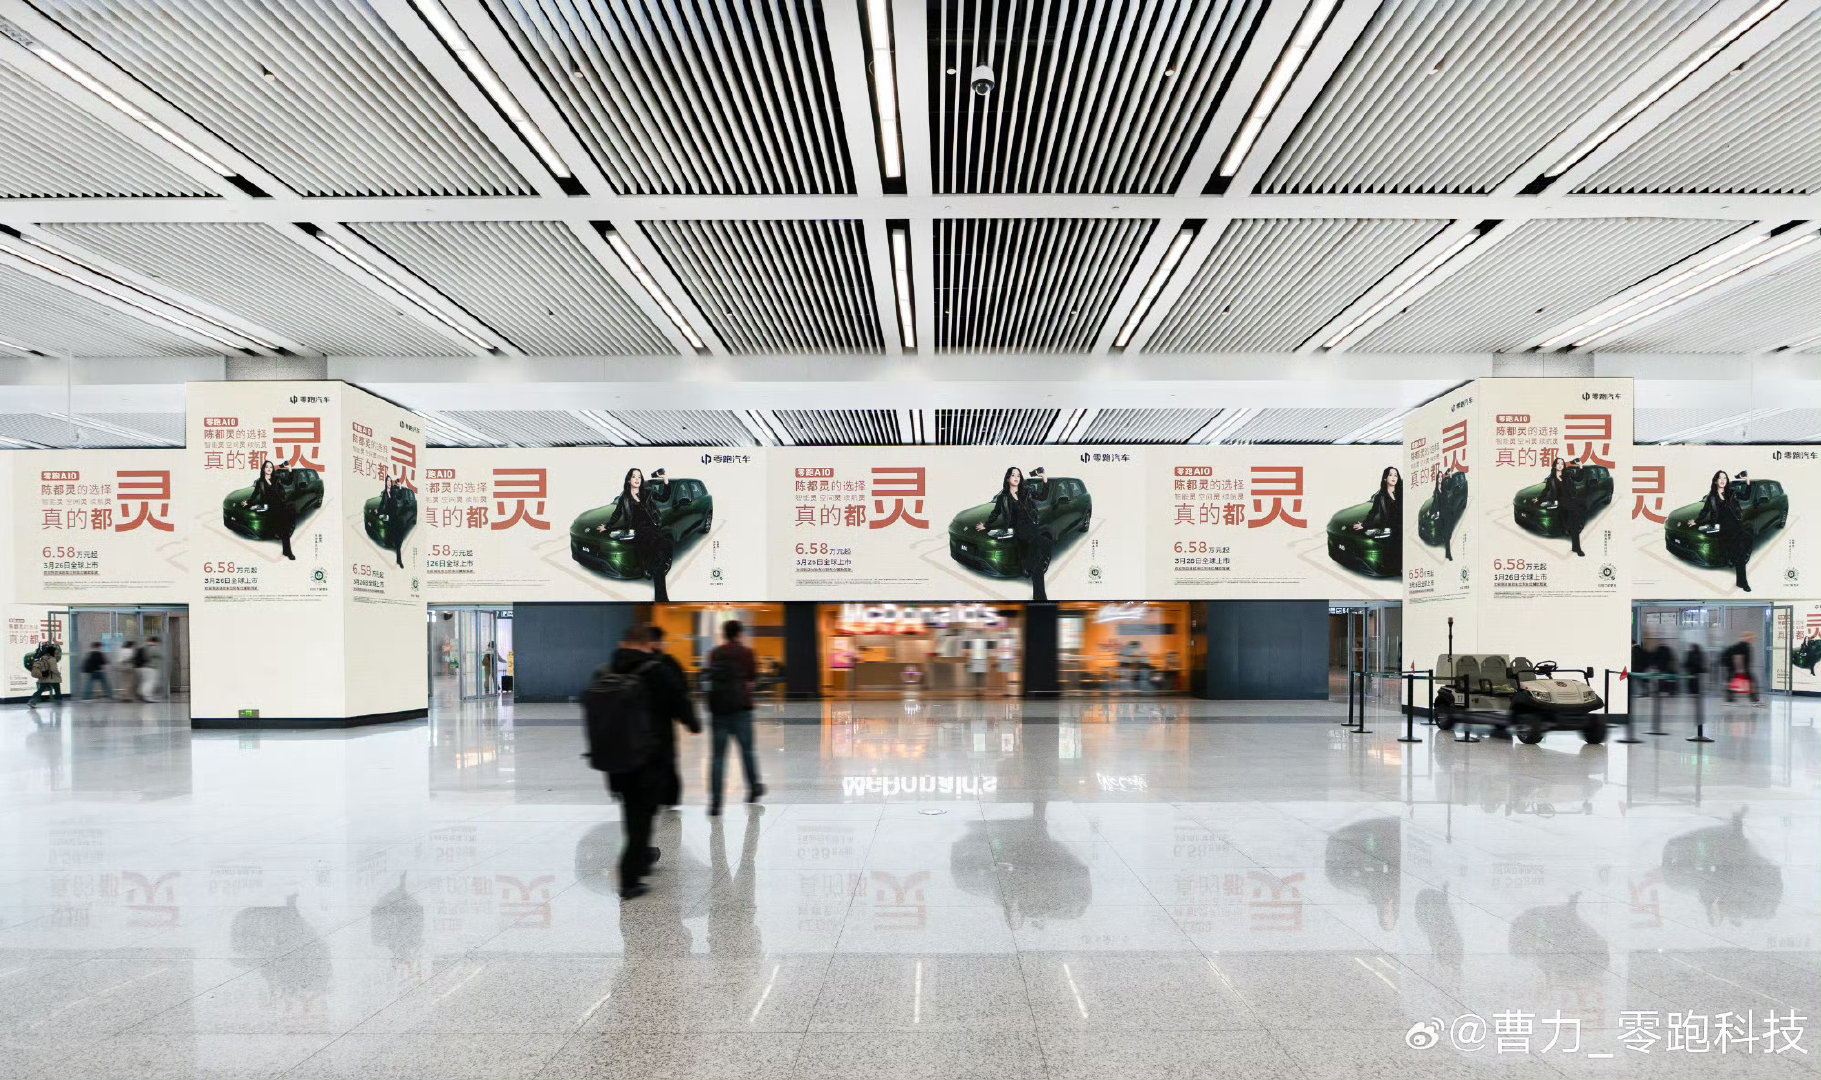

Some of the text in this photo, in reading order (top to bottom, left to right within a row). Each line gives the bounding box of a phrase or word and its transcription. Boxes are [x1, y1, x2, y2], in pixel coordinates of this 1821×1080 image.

[204, 429, 267, 439] 陈都灵的选择
[1496, 426, 1559, 436] 陈都灵的选择
[272, 417, 325, 472] 灵
[1564, 414, 1615, 469] 灵
[1442, 419, 1469, 478] 灵
[204, 450, 268, 470] 真的都
[713, 455, 751, 463] 零跑汽车
[1093, 453, 1130, 462] 零跑汽车
[1496, 447, 1559, 467] 真的都
[353, 455, 388, 481] 真的都
[390, 436, 418, 494] 灵
[1176, 467, 1211, 476] 零跑A10
[797, 468, 831, 477] 零跑A10
[42, 484, 112, 496] 陈都灵的选择
[426, 482, 487, 493] 都灵的选择
[795, 480, 866, 492] 陈都灵的选择
[1174, 479, 1245, 491] 陈都灵的选择
[115, 470, 175, 532] 灵
[491, 468, 551, 531] 灵
[869, 467, 929, 530] 灵
[1247, 466, 1308, 529] 灵
[41, 508, 113, 530] 真的都
[795, 504, 867, 527] 真的都
[1174, 502, 1246, 526] 真的都
[42, 546, 99, 559] 6.58万元起
[795, 542, 852, 555] 6.58万元起
[1174, 541, 1230, 554] 6.58万元起
[43, 561, 99, 570] 3月26日全球上市
[203, 562, 258, 574] 6.58万元起
[1493, 559, 1547, 570] 6.58万元起
